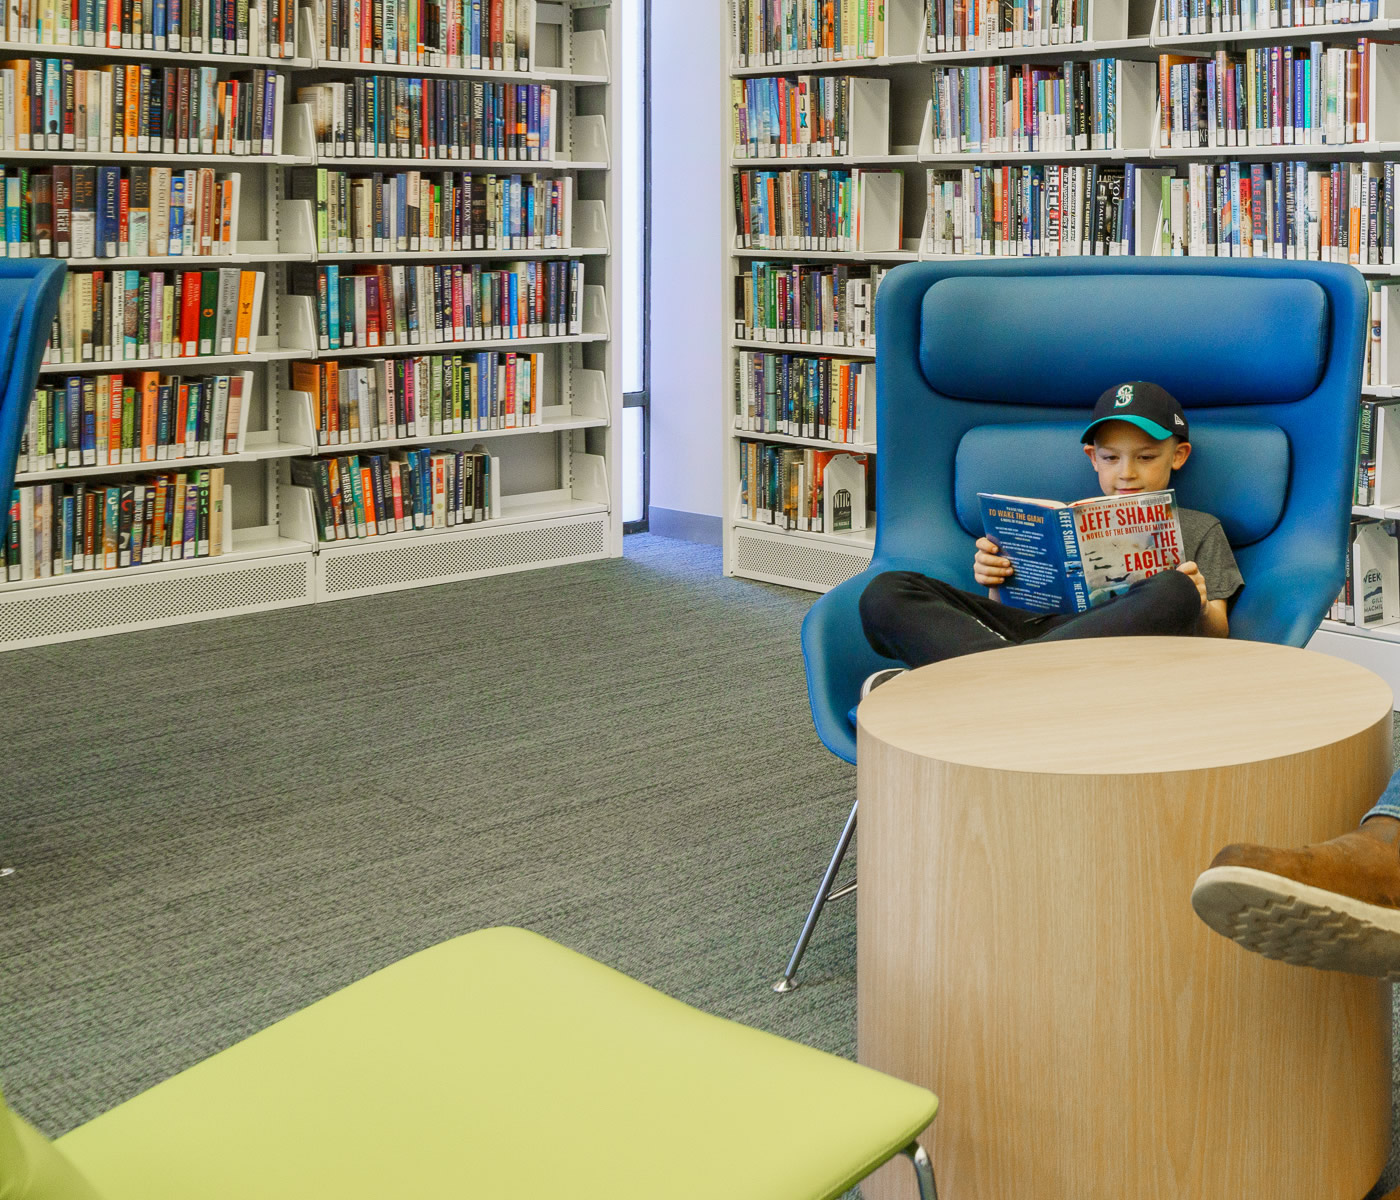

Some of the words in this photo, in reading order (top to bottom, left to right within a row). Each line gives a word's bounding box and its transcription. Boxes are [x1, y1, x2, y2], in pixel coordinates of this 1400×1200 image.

[66, 74, 74, 85] JOY
[66, 86, 74, 110] FIELDING
[107, 172, 115, 188] KEN
[1253, 168, 1262, 196] GALE
[107, 189, 115, 219] FOLLETT
[1112, 179, 1120, 206] YOU
[1253, 200, 1262, 235] FORCE
[989, 508, 997, 516] TO
[997, 510, 1015, 519] WAKE
[1015, 511, 1026, 520] THE
[1026, 514, 1045, 524] GIANT
[1059, 511, 1073, 528] JEFF
[1079, 510, 1111, 533] JEFF
[1115, 504, 1174, 526] SHAARA
[1086, 532, 1104, 541] NOVEL
[1105, 529, 1112, 537] OF
[1113, 528, 1124, 536] THE
[1125, 525, 1144, 534] BATTLE
[1145, 524, 1152, 532] OF
[1152, 521, 1176, 530] MIDWAY
[1151, 530, 1178, 548] THE
[1124, 547, 1181, 572] EAGLE'S
[1075, 591, 1087, 613] EAGLE
